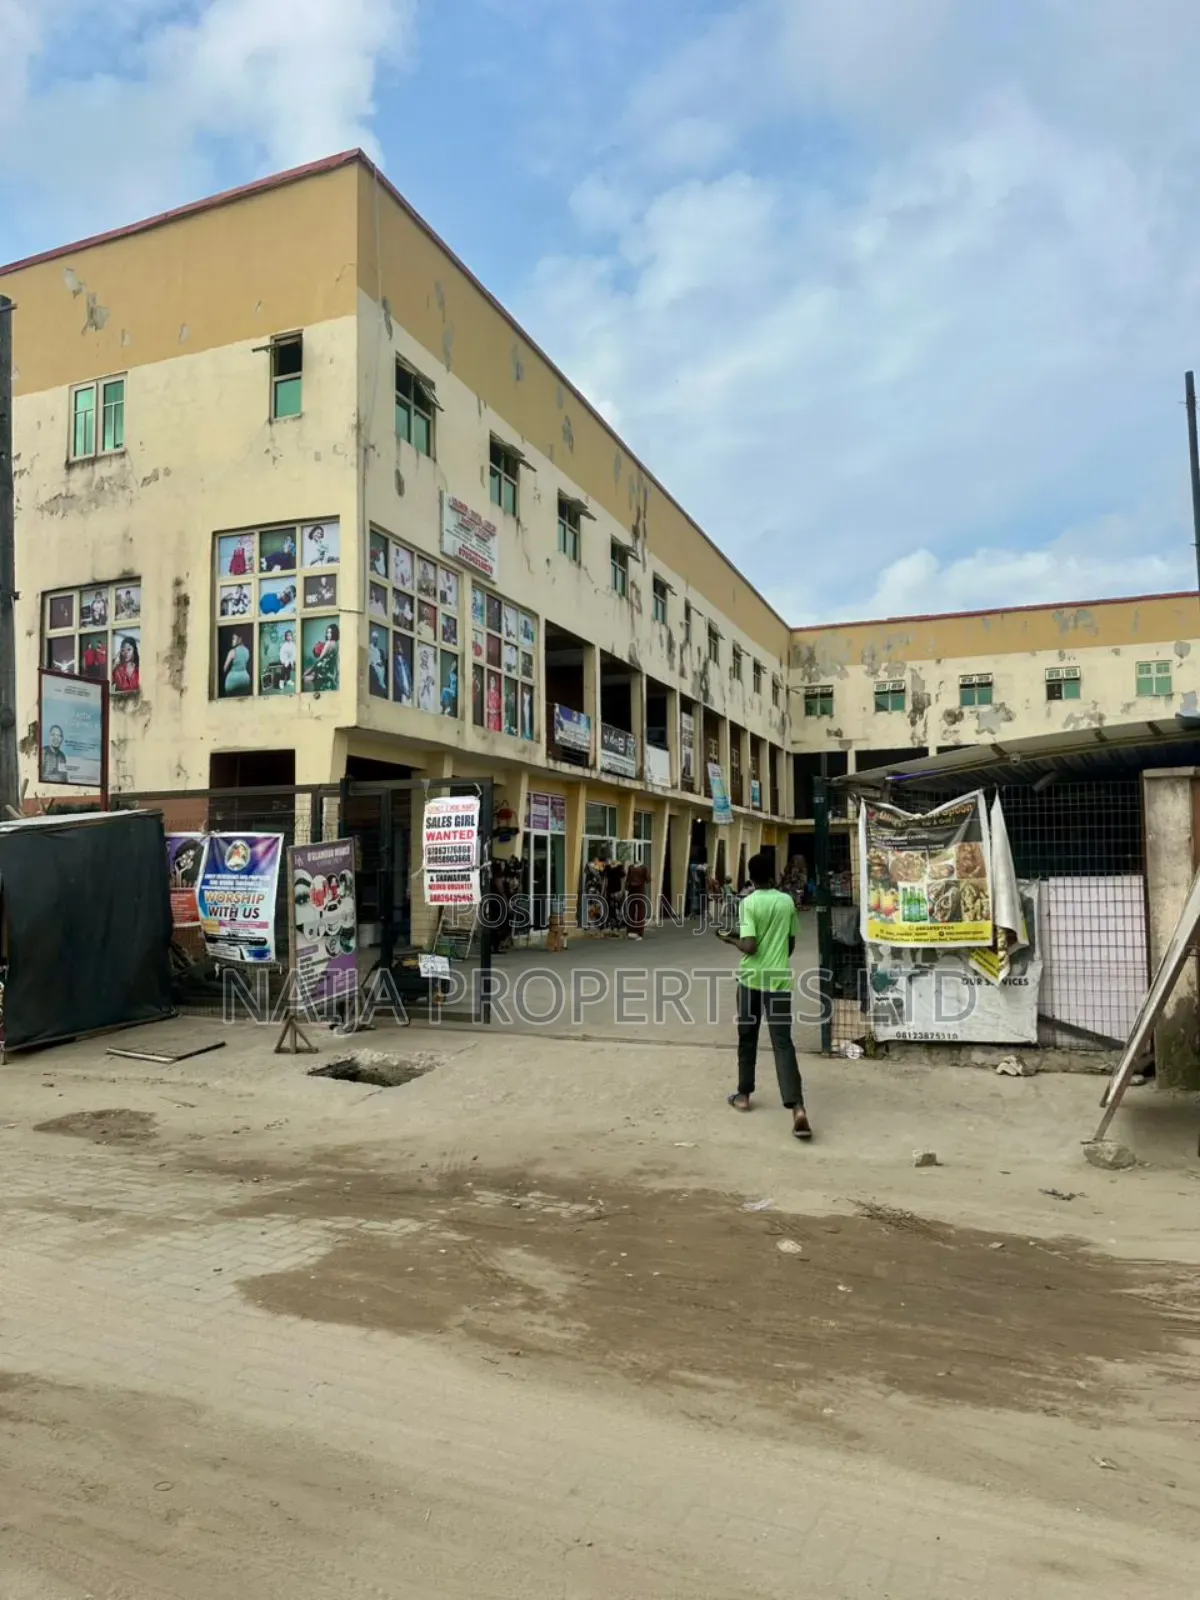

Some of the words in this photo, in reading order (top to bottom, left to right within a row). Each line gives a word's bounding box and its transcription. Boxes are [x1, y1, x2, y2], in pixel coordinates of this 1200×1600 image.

[426, 816, 452, 829] SALES
[454, 814, 475, 827] GIRL
[426, 829, 474, 841] WANTED
[206, 891, 265, 905] WORSHIP
[209, 905, 239, 918] WITH
[243, 906, 260, 919] US
[984, 978, 1030, 987] SVICES
